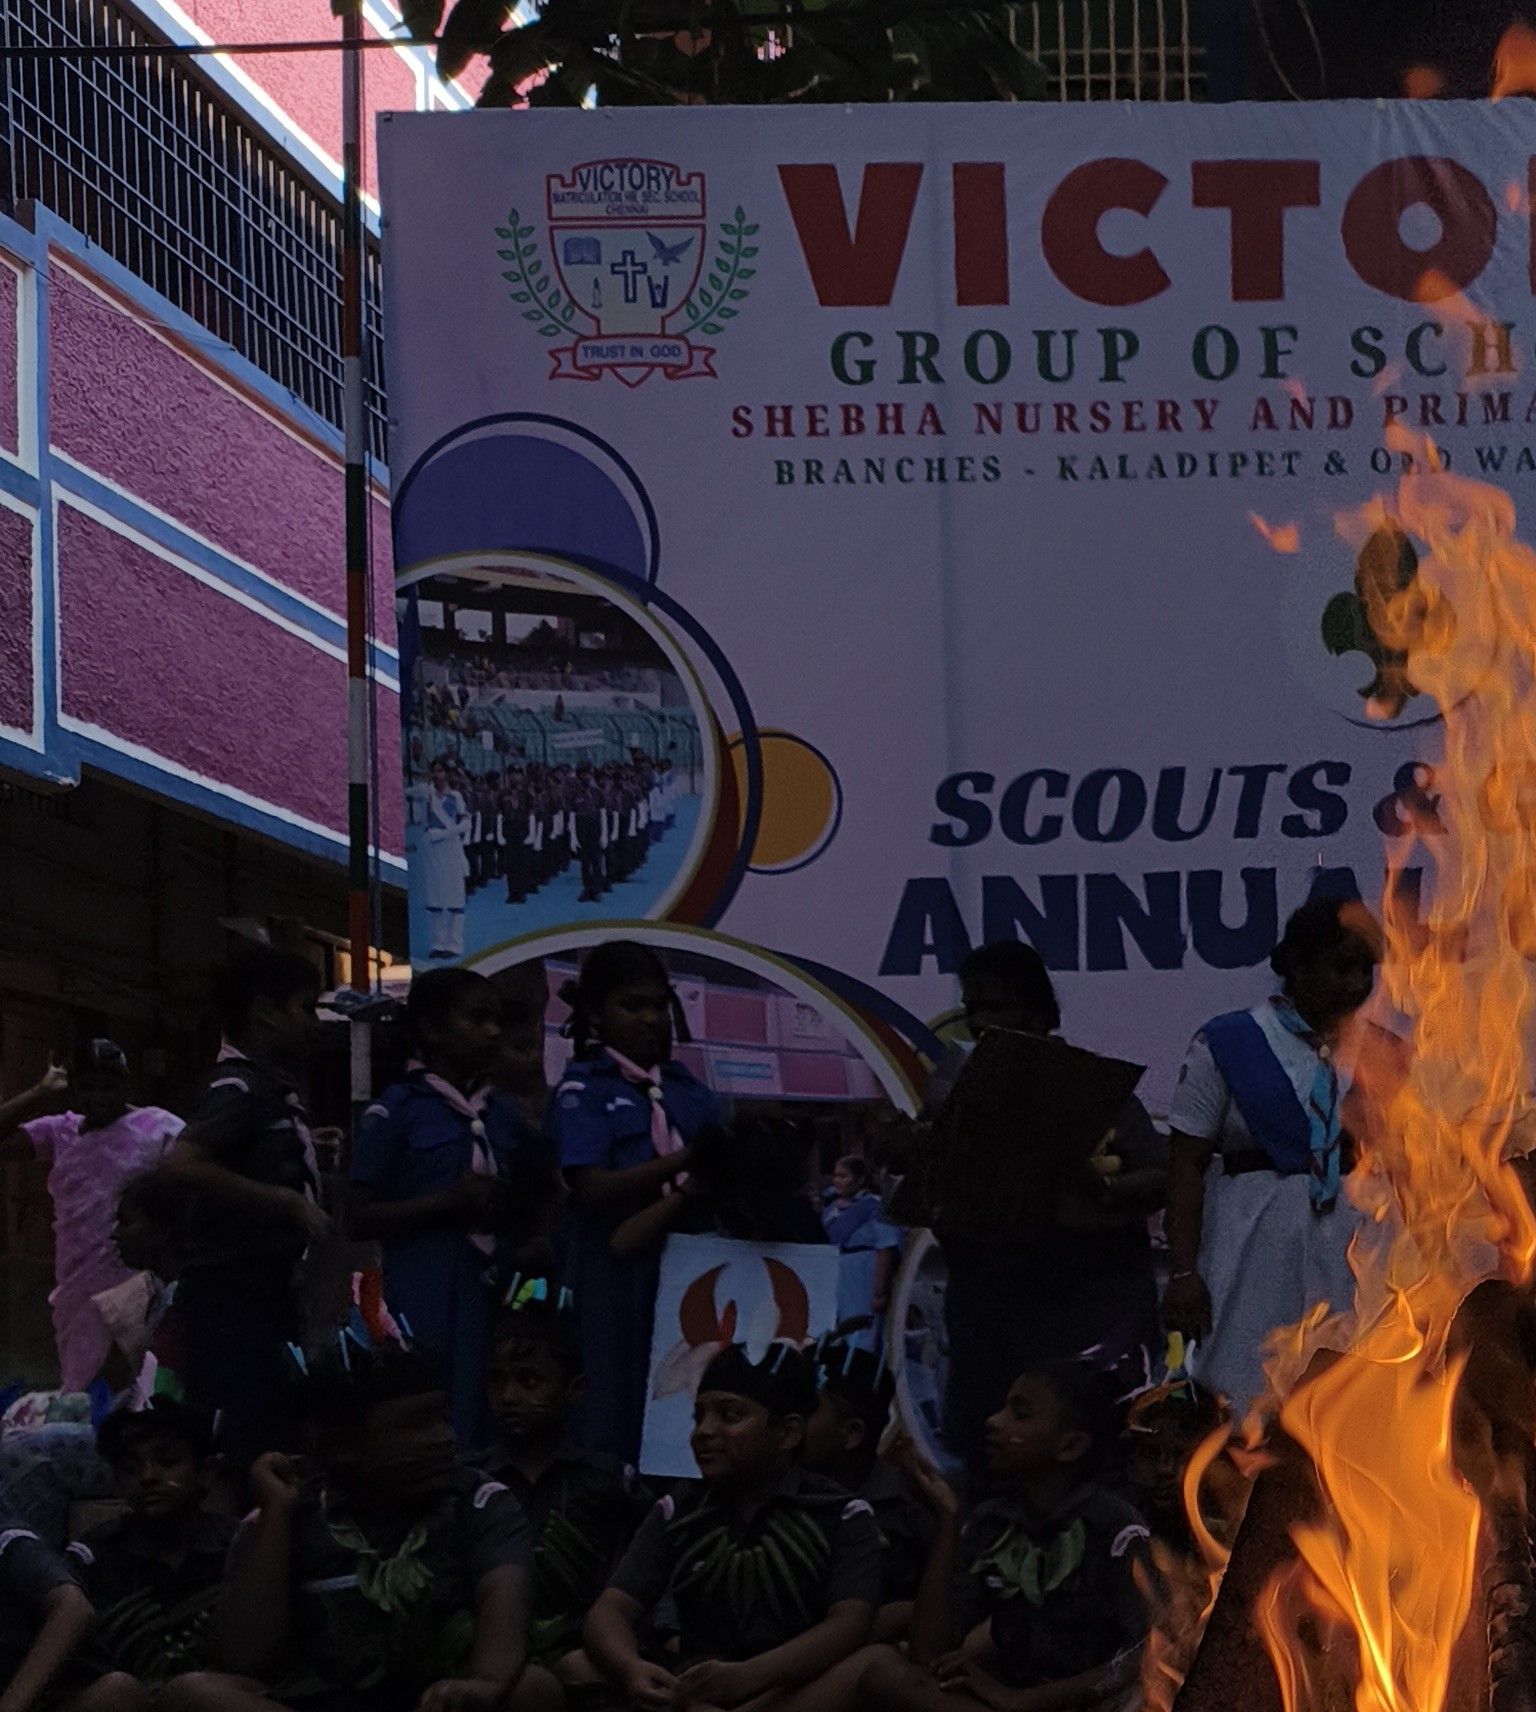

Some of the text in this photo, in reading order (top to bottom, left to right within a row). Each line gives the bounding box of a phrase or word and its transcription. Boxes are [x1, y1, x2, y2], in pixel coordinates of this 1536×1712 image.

[577, 162, 674, 192] VICTORY
[582, 344, 682, 359] TRUST IN GOD
[829, 327, 1140, 386] GROUP
[1191, 324, 1299, 382] OF
[731, 401, 947, 439] SHEBHA
[974, 398, 1220, 435] NURSERY
[1250, 395, 1354, 431] AND
[774, 455, 1002, 486] BRANCHES
[1057, 450, 1297, 481] KALADIPET
[1323, 449, 1348, 476] &
[928, 760, 1353, 847] SCOUTS
[1373, 761, 1447, 837] &
